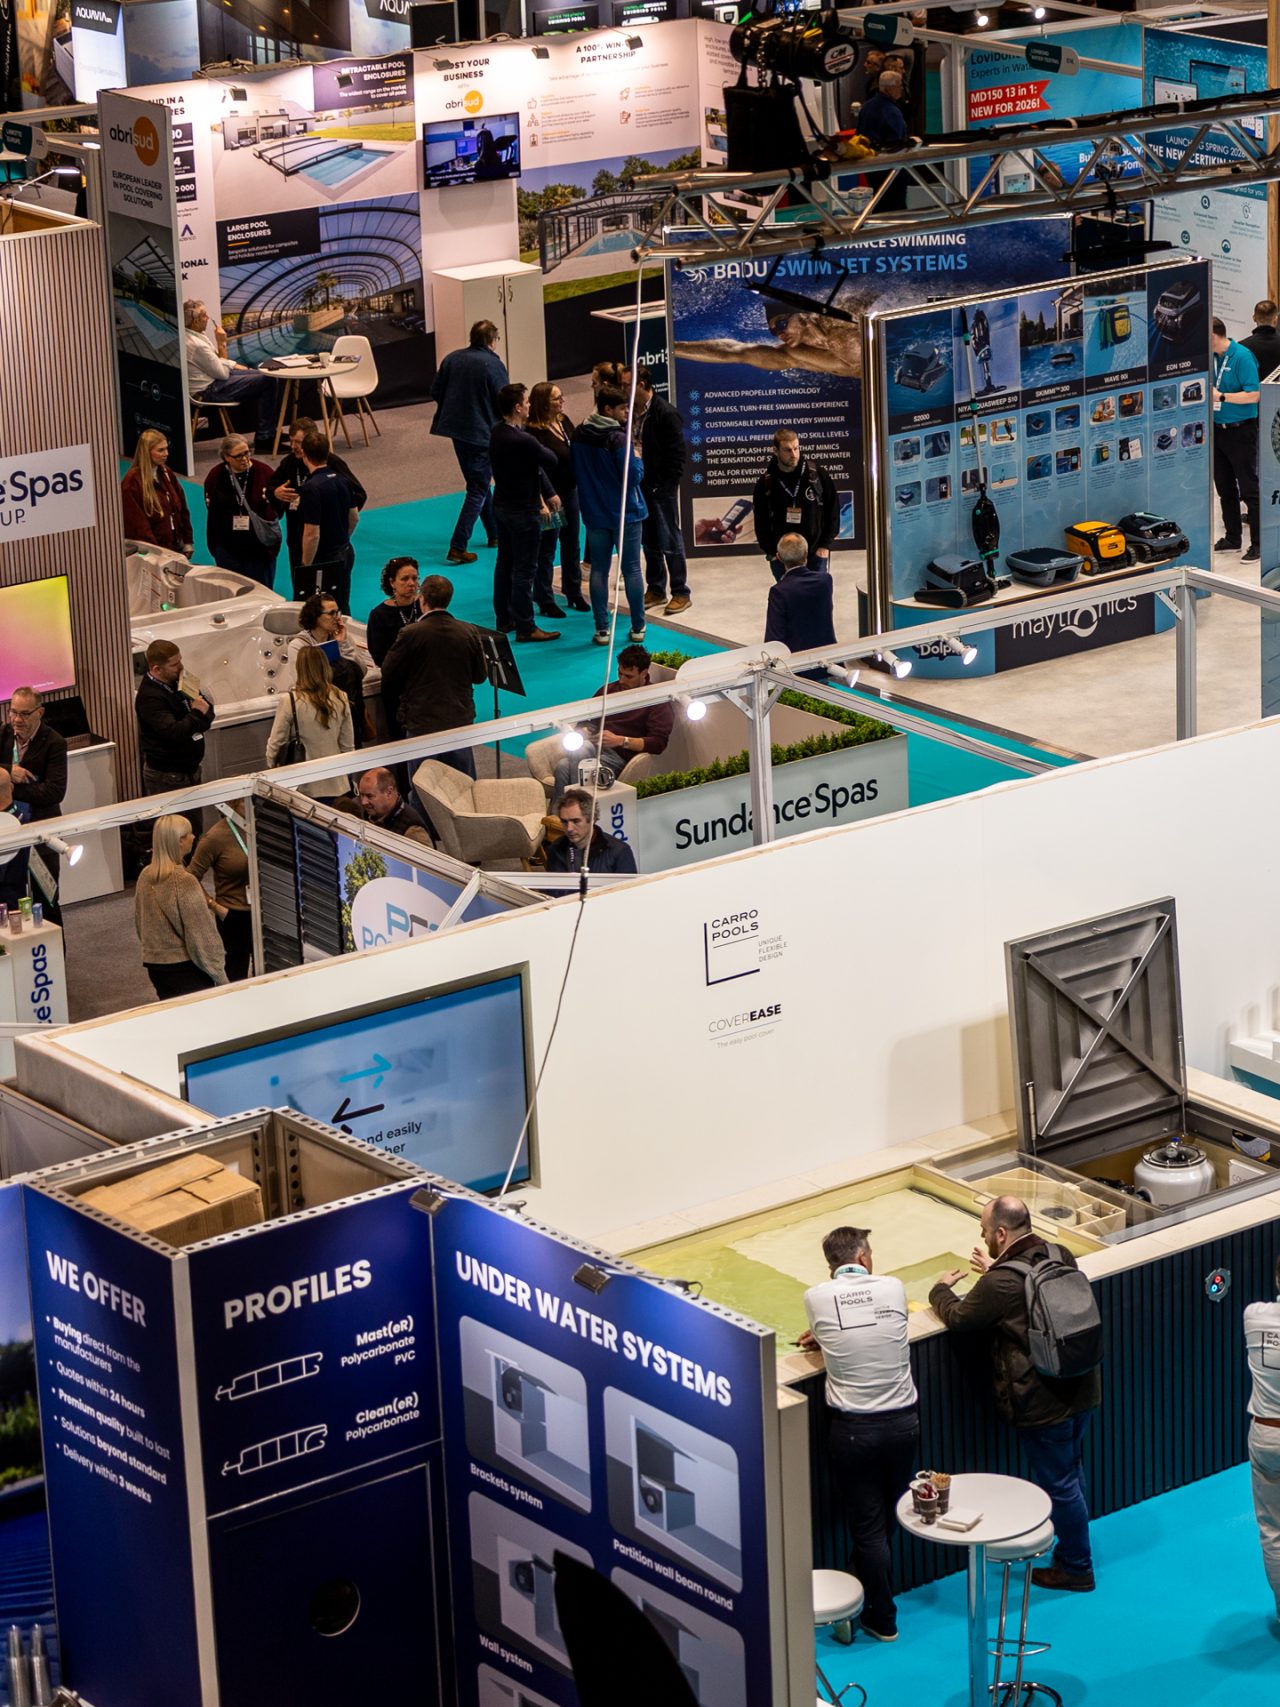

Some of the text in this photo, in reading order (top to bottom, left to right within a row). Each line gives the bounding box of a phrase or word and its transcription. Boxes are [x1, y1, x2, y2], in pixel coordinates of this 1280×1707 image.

[466, 58, 490, 67] YOUR
[580, 51, 636, 63] PARTNERSHIP
[341, 63, 387, 75] RETRACTABLE
[364, 70, 406, 80] ENCLOSURES
[444, 71, 484, 82] BUSINESS
[971, 89, 1002, 103] MD150
[1005, 87, 1015, 98] 13
[1018, 85, 1026, 97] in
[970, 98, 1040, 119] NEW FOR 2026!
[109, 124, 155, 151] abrisud
[1149, 144, 1185, 160] THE NEW
[1205, 141, 1245, 159] SPRING 2026
[112, 170, 162, 190] EUROPEAN LEADER
[118, 184, 134, 194] POOL
[136, 188, 162, 201] COVERING
[227, 221, 268, 232] LARGE POOL
[227, 229, 271, 241] ENCLOSURES
[890, 234, 966, 247] SWIMMING
[713, 253, 968, 279] BADU SWIM JET SYSTEMS
[704, 390, 740, 398] ADVANCED
[705, 406, 738, 414] SEAMLESS,
[740, 404, 774, 412] TURN-FREE
[914, 414, 930, 422] S2000
[706, 421, 753, 429] CUSTOMISABLE
[750, 433, 774, 441] PREFER
[707, 448, 735, 456] SMOOTH,
[10, 469, 84, 507] Spas
[731, 477, 759, 485] SWIMME
[1012, 593, 1137, 639] maytronics
[815, 778, 878, 818] Spas
[712, 909, 758, 928] CARRO
[712, 922, 759, 942] POOLS
[758, 935, 782, 947] UNIQUE
[31, 944, 53, 1004] Spas
[709, 1004, 782, 1033] COVEREASE
[386, 1120, 422, 1140] easily
[45, 1249, 146, 1328] WE OFFER
[224, 1259, 372, 1329] PROFILES
[356, 1315, 414, 1346] Mast(eR)
[456, 1251, 732, 1407] UNDER WATER SYSTEMS
[52, 1316, 140, 1373] Buying direct from the
[54, 1334, 112, 1374] manufacturers
[341, 1335, 415, 1367] Polycarbonate
[394, 1350, 415, 1365] PVC
[56, 1360, 145, 1418] Quotes within 24 hours
[356, 1391, 419, 1424] Clean(eR)
[58, 1388, 170, 1460] Premium quality built to last
[346, 1409, 419, 1441] Polycarbonate
[61, 1415, 166, 1484] Solutions beyond standard
[63, 1443, 151, 1503] Delivery within 3 weeks
[470, 1462, 543, 1510] Brackets system
[613, 1538, 733, 1610] Partition wall beam round
[480, 1634, 533, 1673] Wall system
